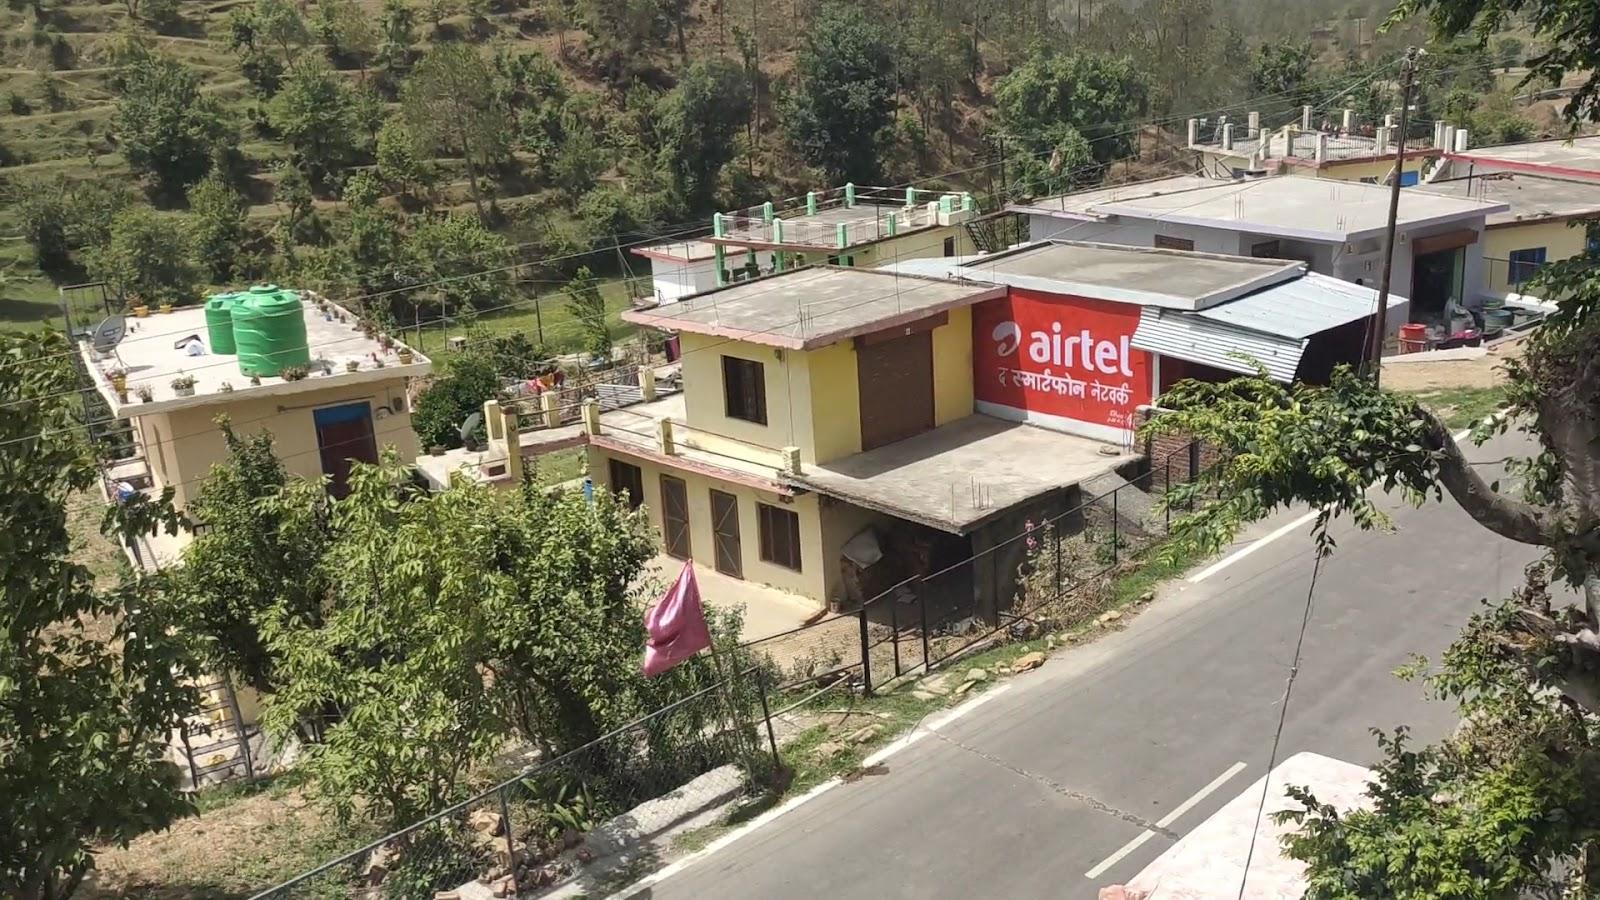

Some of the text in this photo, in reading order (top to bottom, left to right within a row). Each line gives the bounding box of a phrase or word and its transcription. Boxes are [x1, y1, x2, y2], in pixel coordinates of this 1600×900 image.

[1029, 321, 1133, 377] airtel
[1011, 368, 1088, 399] स्मार्टफोन
[1090, 379, 1134, 406] नेटवर्क
